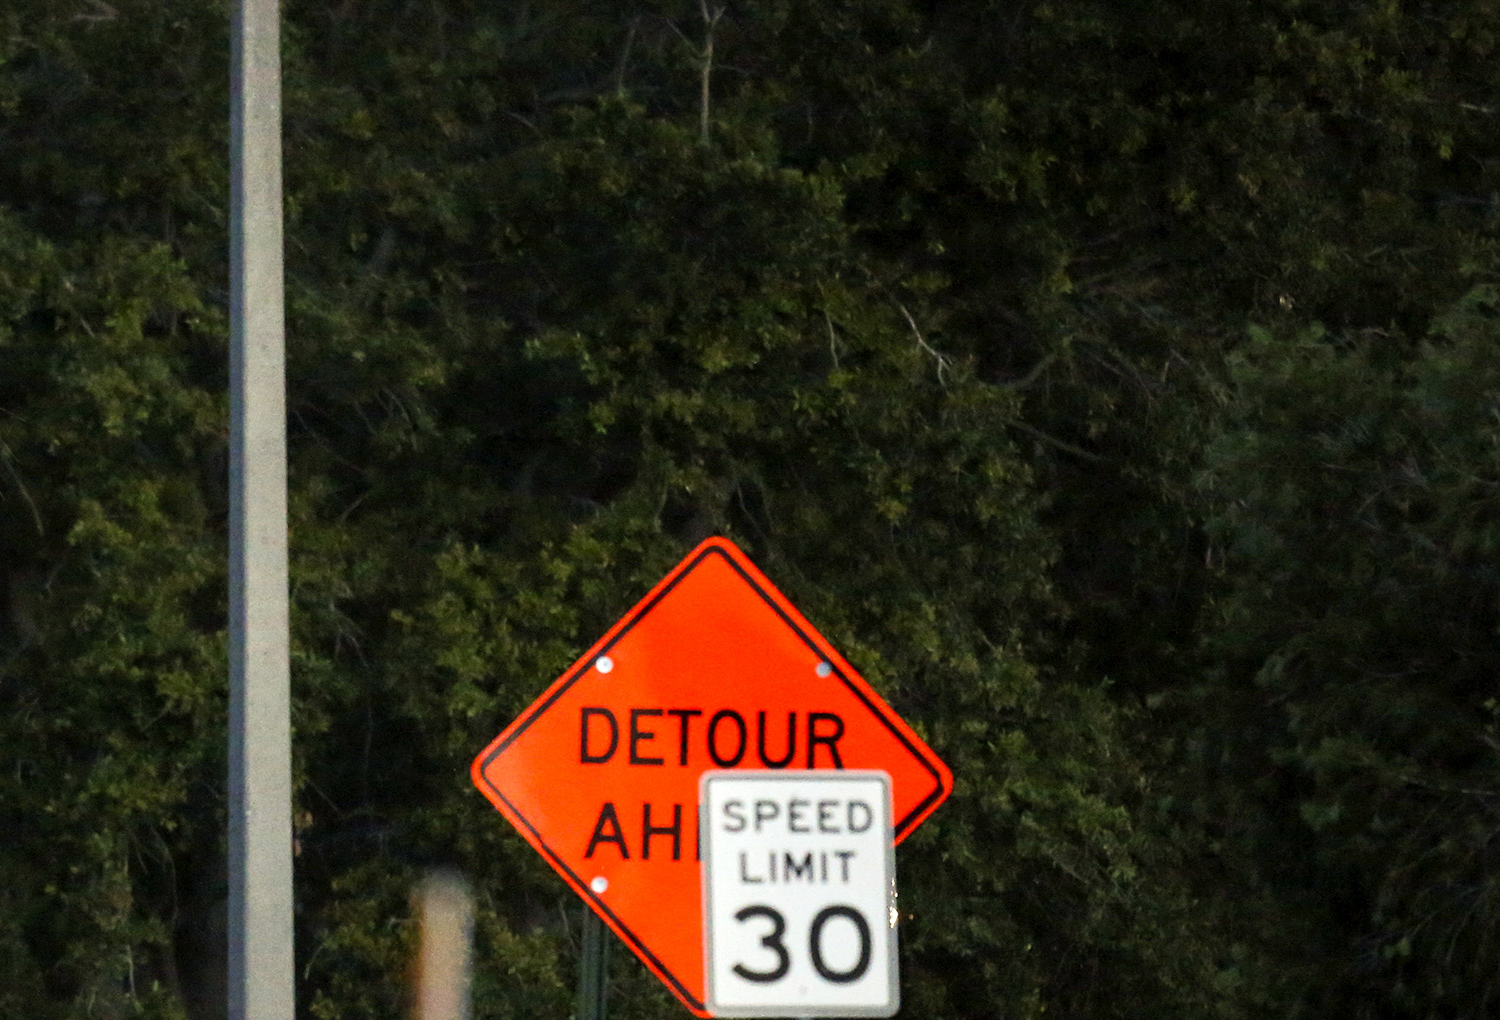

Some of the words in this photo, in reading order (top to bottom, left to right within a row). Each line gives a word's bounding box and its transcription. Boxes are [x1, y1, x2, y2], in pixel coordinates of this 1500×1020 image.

[579, 707, 846, 769] DETOUR
[584, 801, 701, 862] AH
[722, 799, 873, 833] SPEED
[739, 850, 856, 883] LIMIT
[732, 904, 873, 984] 30
